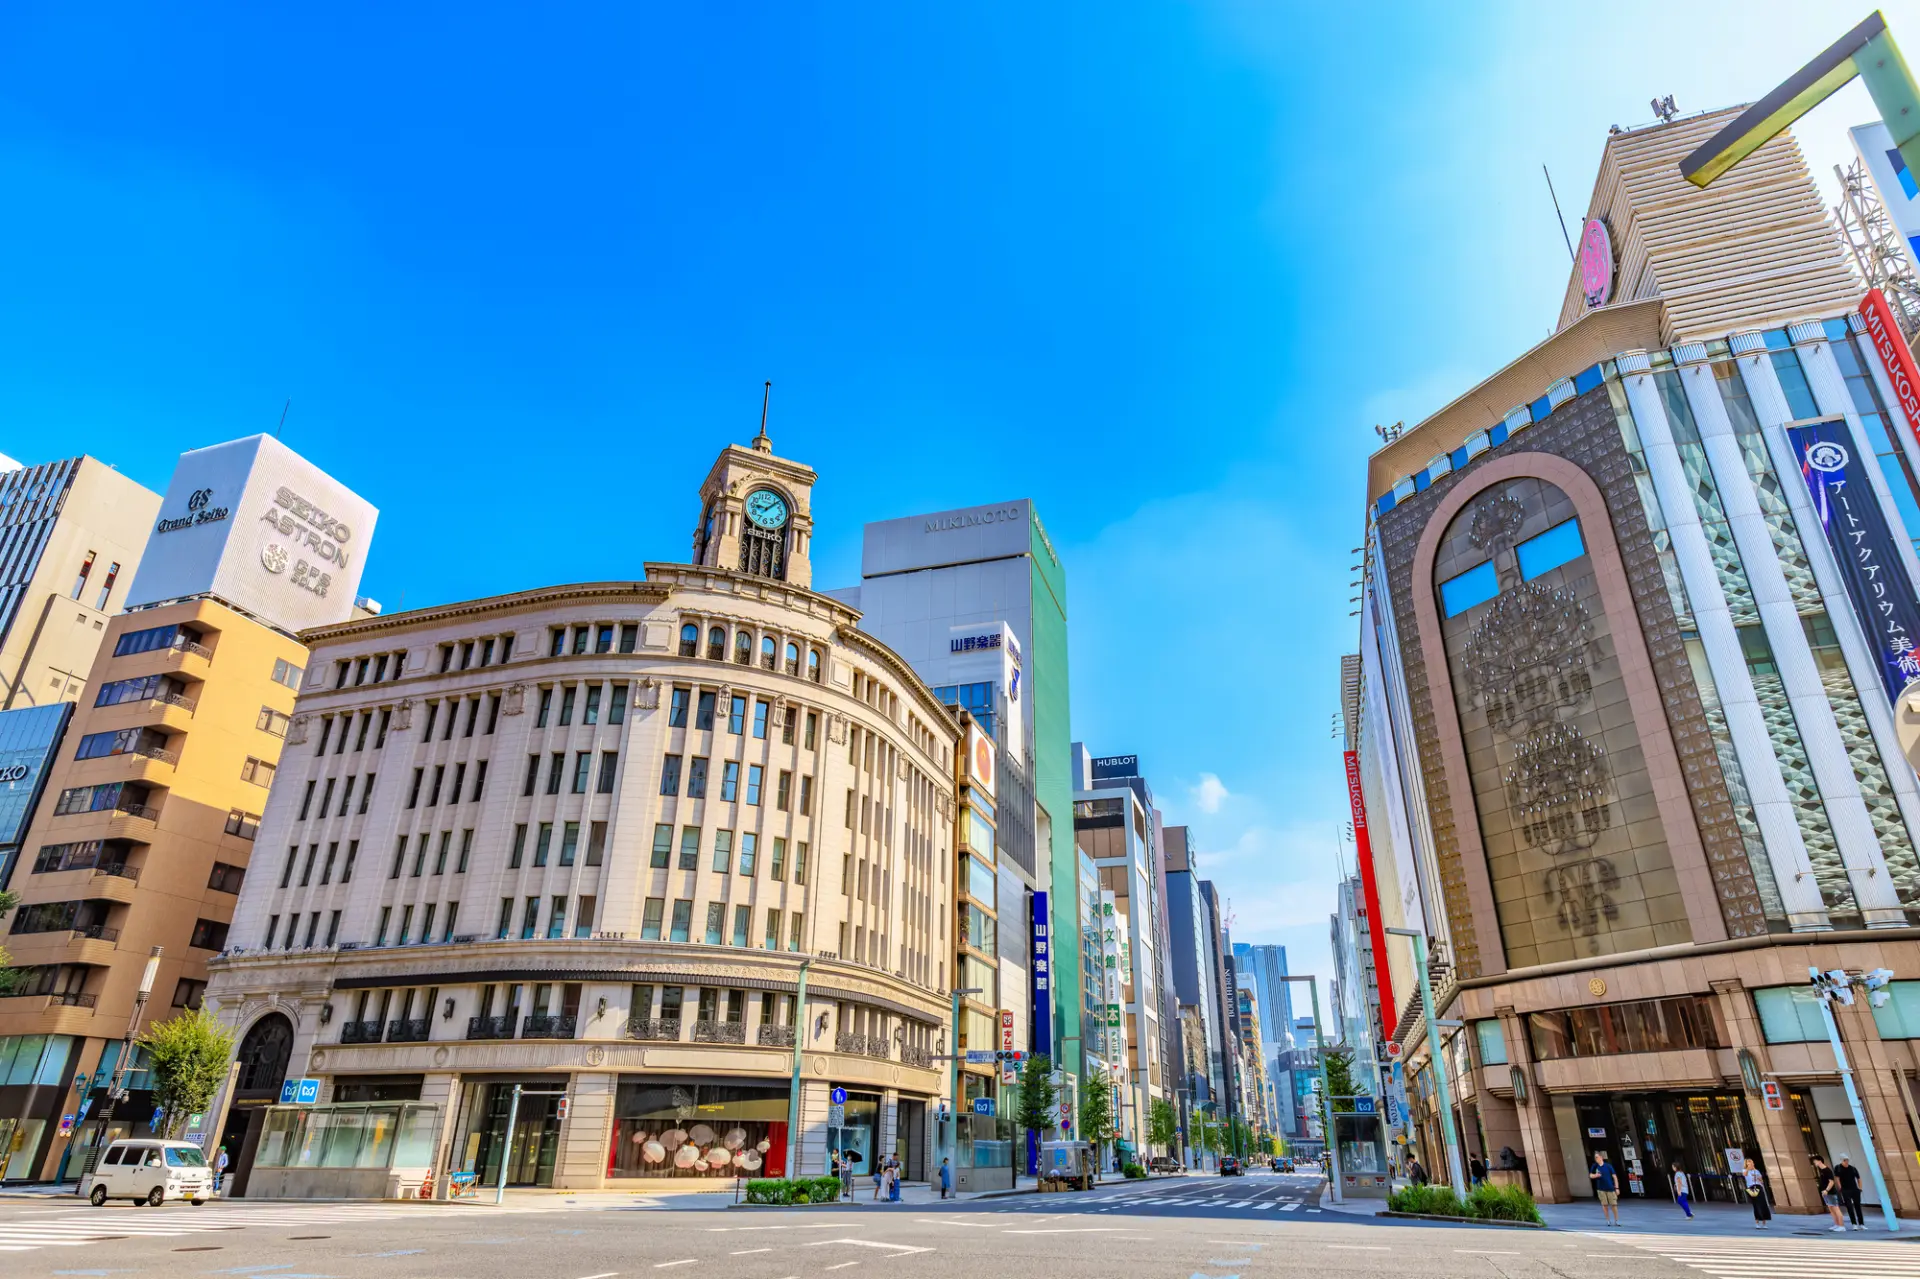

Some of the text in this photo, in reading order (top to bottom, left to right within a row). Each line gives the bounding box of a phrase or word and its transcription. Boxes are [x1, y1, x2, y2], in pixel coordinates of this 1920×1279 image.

[1865, 303, 1920, 440] MITSUKOSH
[188, 488, 213, 511] GS
[158, 507, 230, 532] Grand Seiko
[274, 486, 351, 543] SEIKO
[925, 508, 1020, 533] MIKIMOTO
[260, 507, 350, 569] ASTRON
[747, 527, 783, 543] SEIKO
[294, 559, 332, 588] GPS
[950, 633, 1002, 653] 山野楽器
[0, 765, 27, 782] KO
[1096, 756, 1136, 767] HUBLOT
[1346, 756, 1366, 829] MITSUKOSHI
[1102, 902, 1116, 969] 教文館
[1035, 924, 1048, 990] 山野楽器
[1225, 968, 1236, 1018] BOUCHERON
[1107, 1007, 1119, 1023] 本
